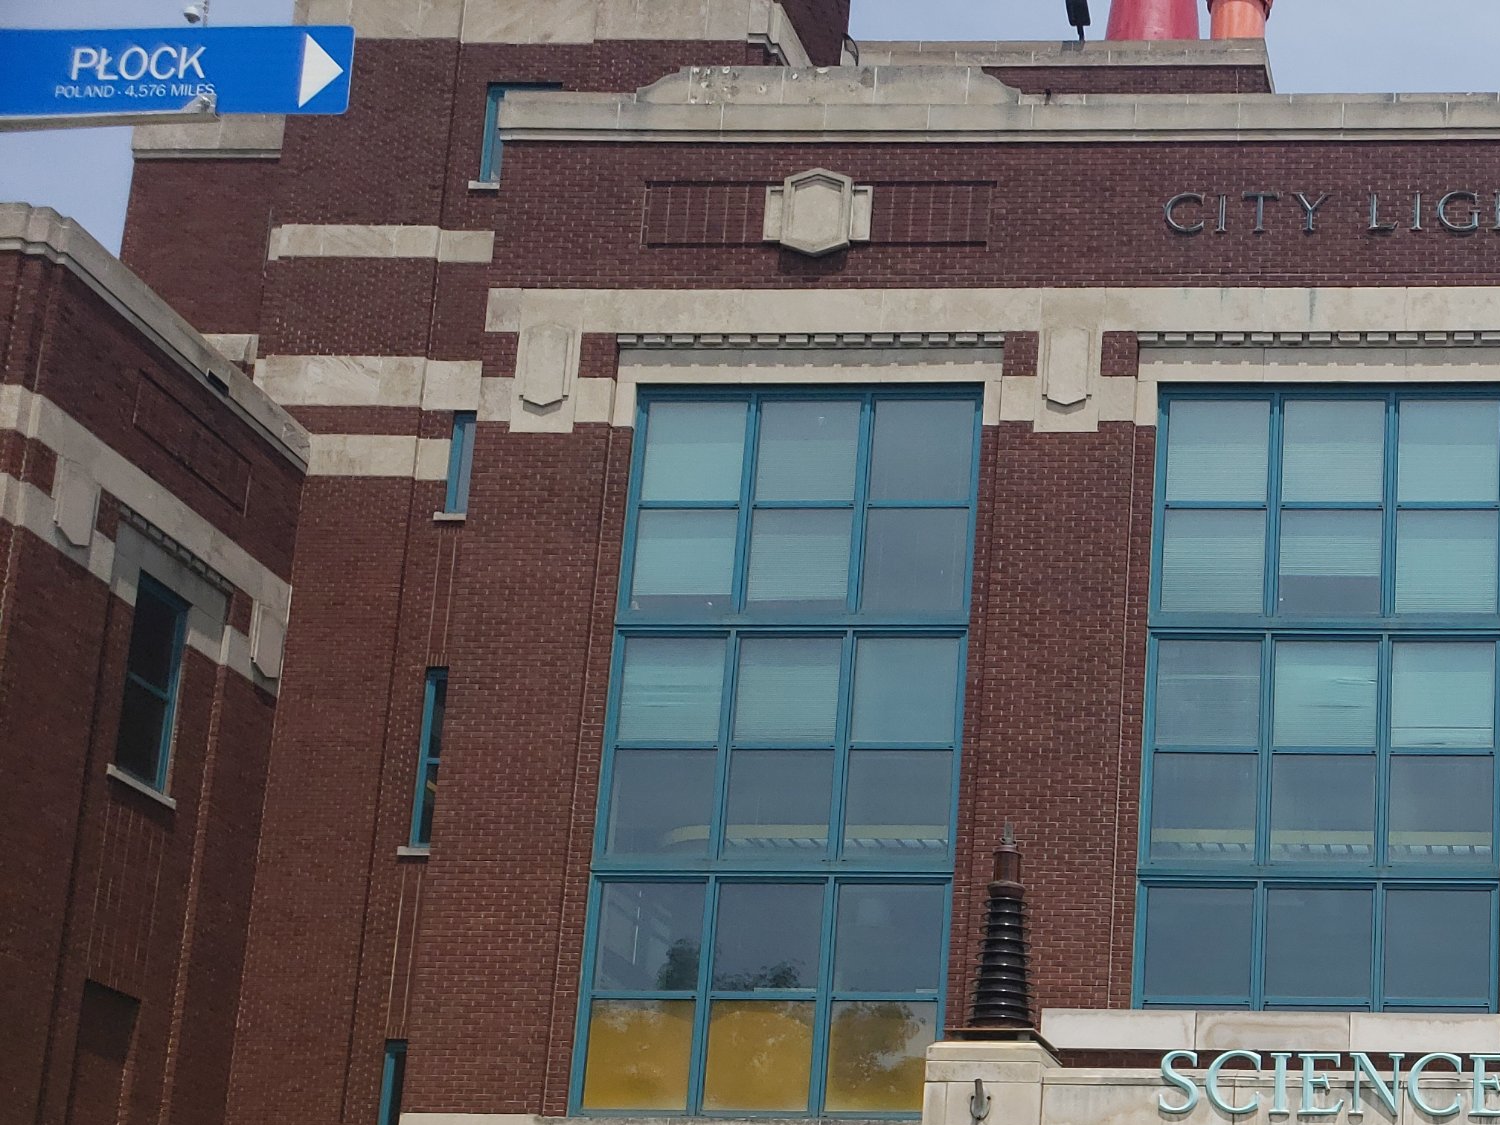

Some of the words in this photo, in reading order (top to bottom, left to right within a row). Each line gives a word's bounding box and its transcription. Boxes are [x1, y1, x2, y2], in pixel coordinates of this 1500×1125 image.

[71, 46, 206, 81] PŁOCK
[55, 85, 115, 98] POLAND
[125, 84, 167, 98] 4,576
[171, 83, 215, 97] MILES
[1164, 191, 1328, 233] CITY
